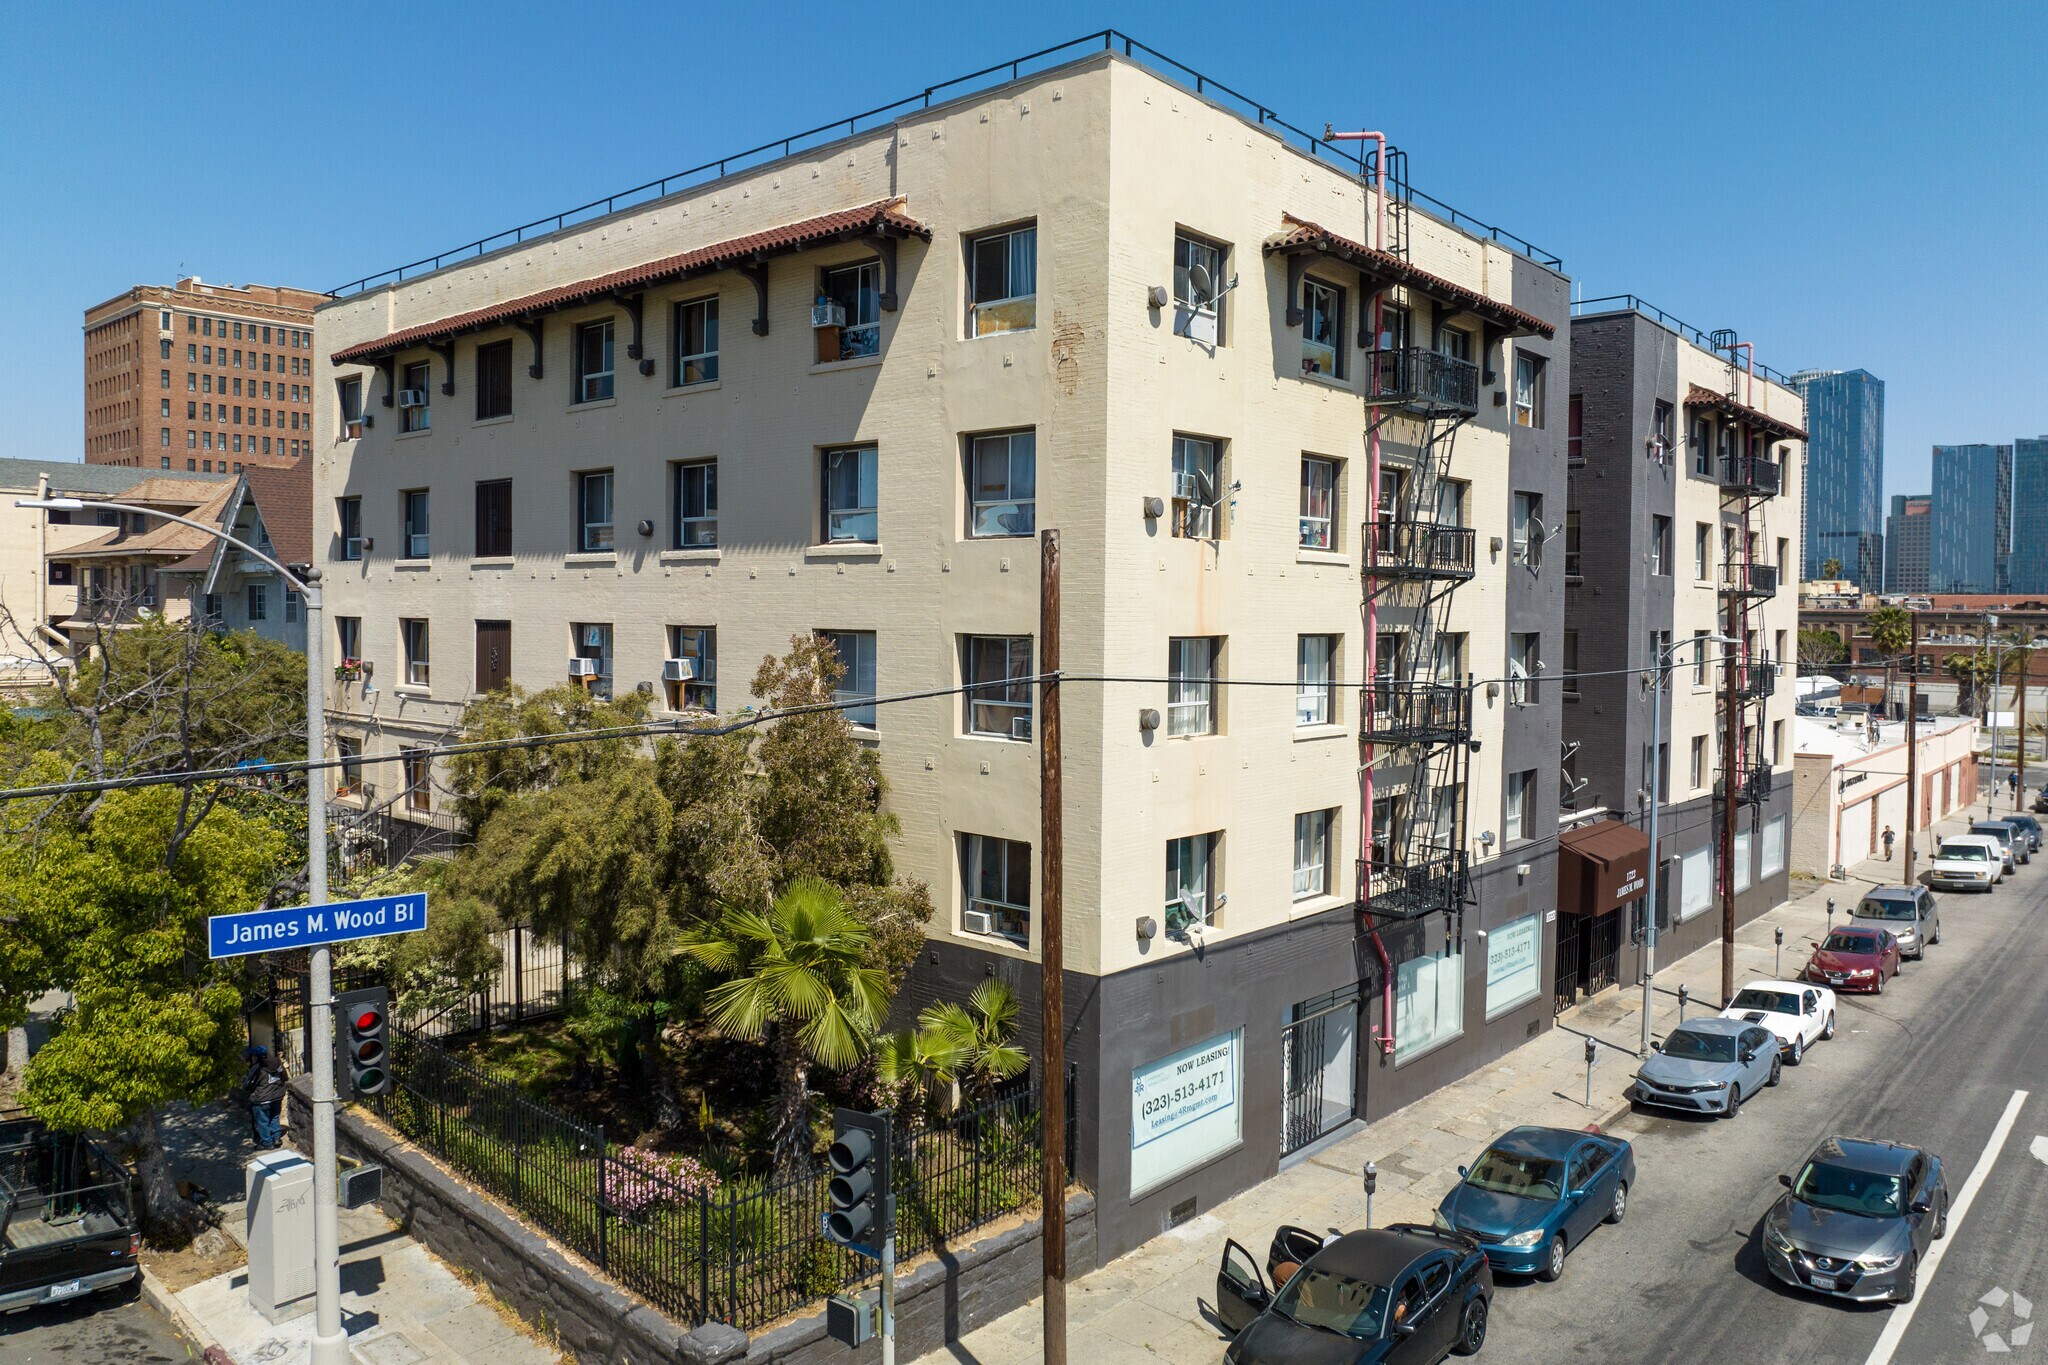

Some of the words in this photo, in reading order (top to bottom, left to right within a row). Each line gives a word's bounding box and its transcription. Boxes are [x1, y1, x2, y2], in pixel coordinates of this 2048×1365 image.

[225, 920, 299, 945] James
[307, 913, 329, 934] M.
[334, 906, 386, 930] Wood
[394, 902, 414, 923] Bl
[1176, 1060, 1194, 1076] NOW
[1196, 1046, 1230, 1067] LEASING!
[1142, 1070, 1224, 1120] (323)-513-4171
